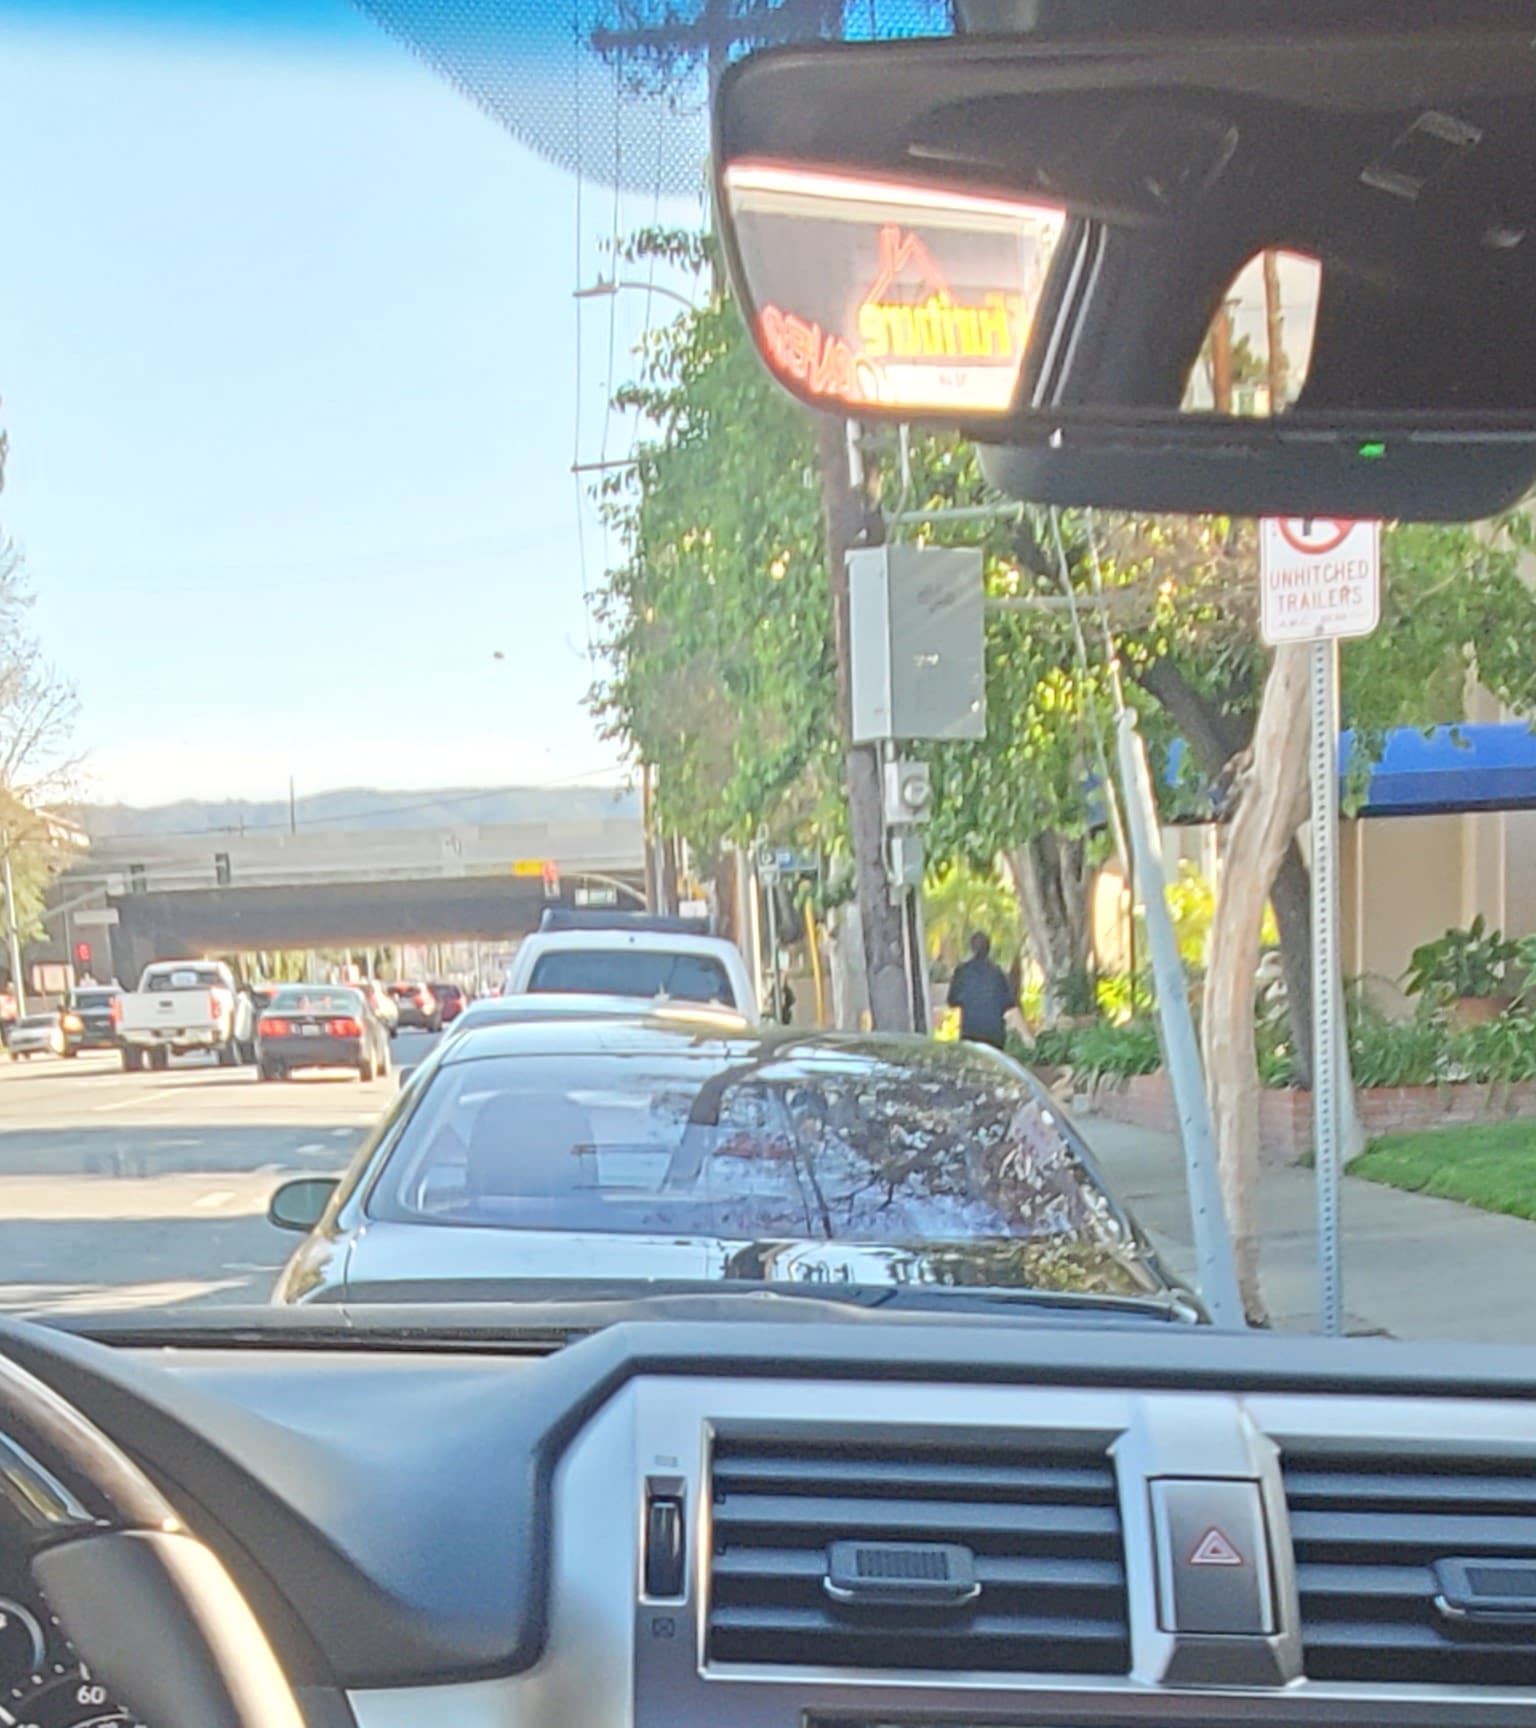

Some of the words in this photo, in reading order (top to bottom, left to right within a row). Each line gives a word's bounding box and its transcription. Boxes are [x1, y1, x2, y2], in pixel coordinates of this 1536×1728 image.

[1270, 560, 1369, 590] UNHITCHED
[1278, 586, 1364, 613] TRAILERS
[77, 1685, 106, 1704] 60
